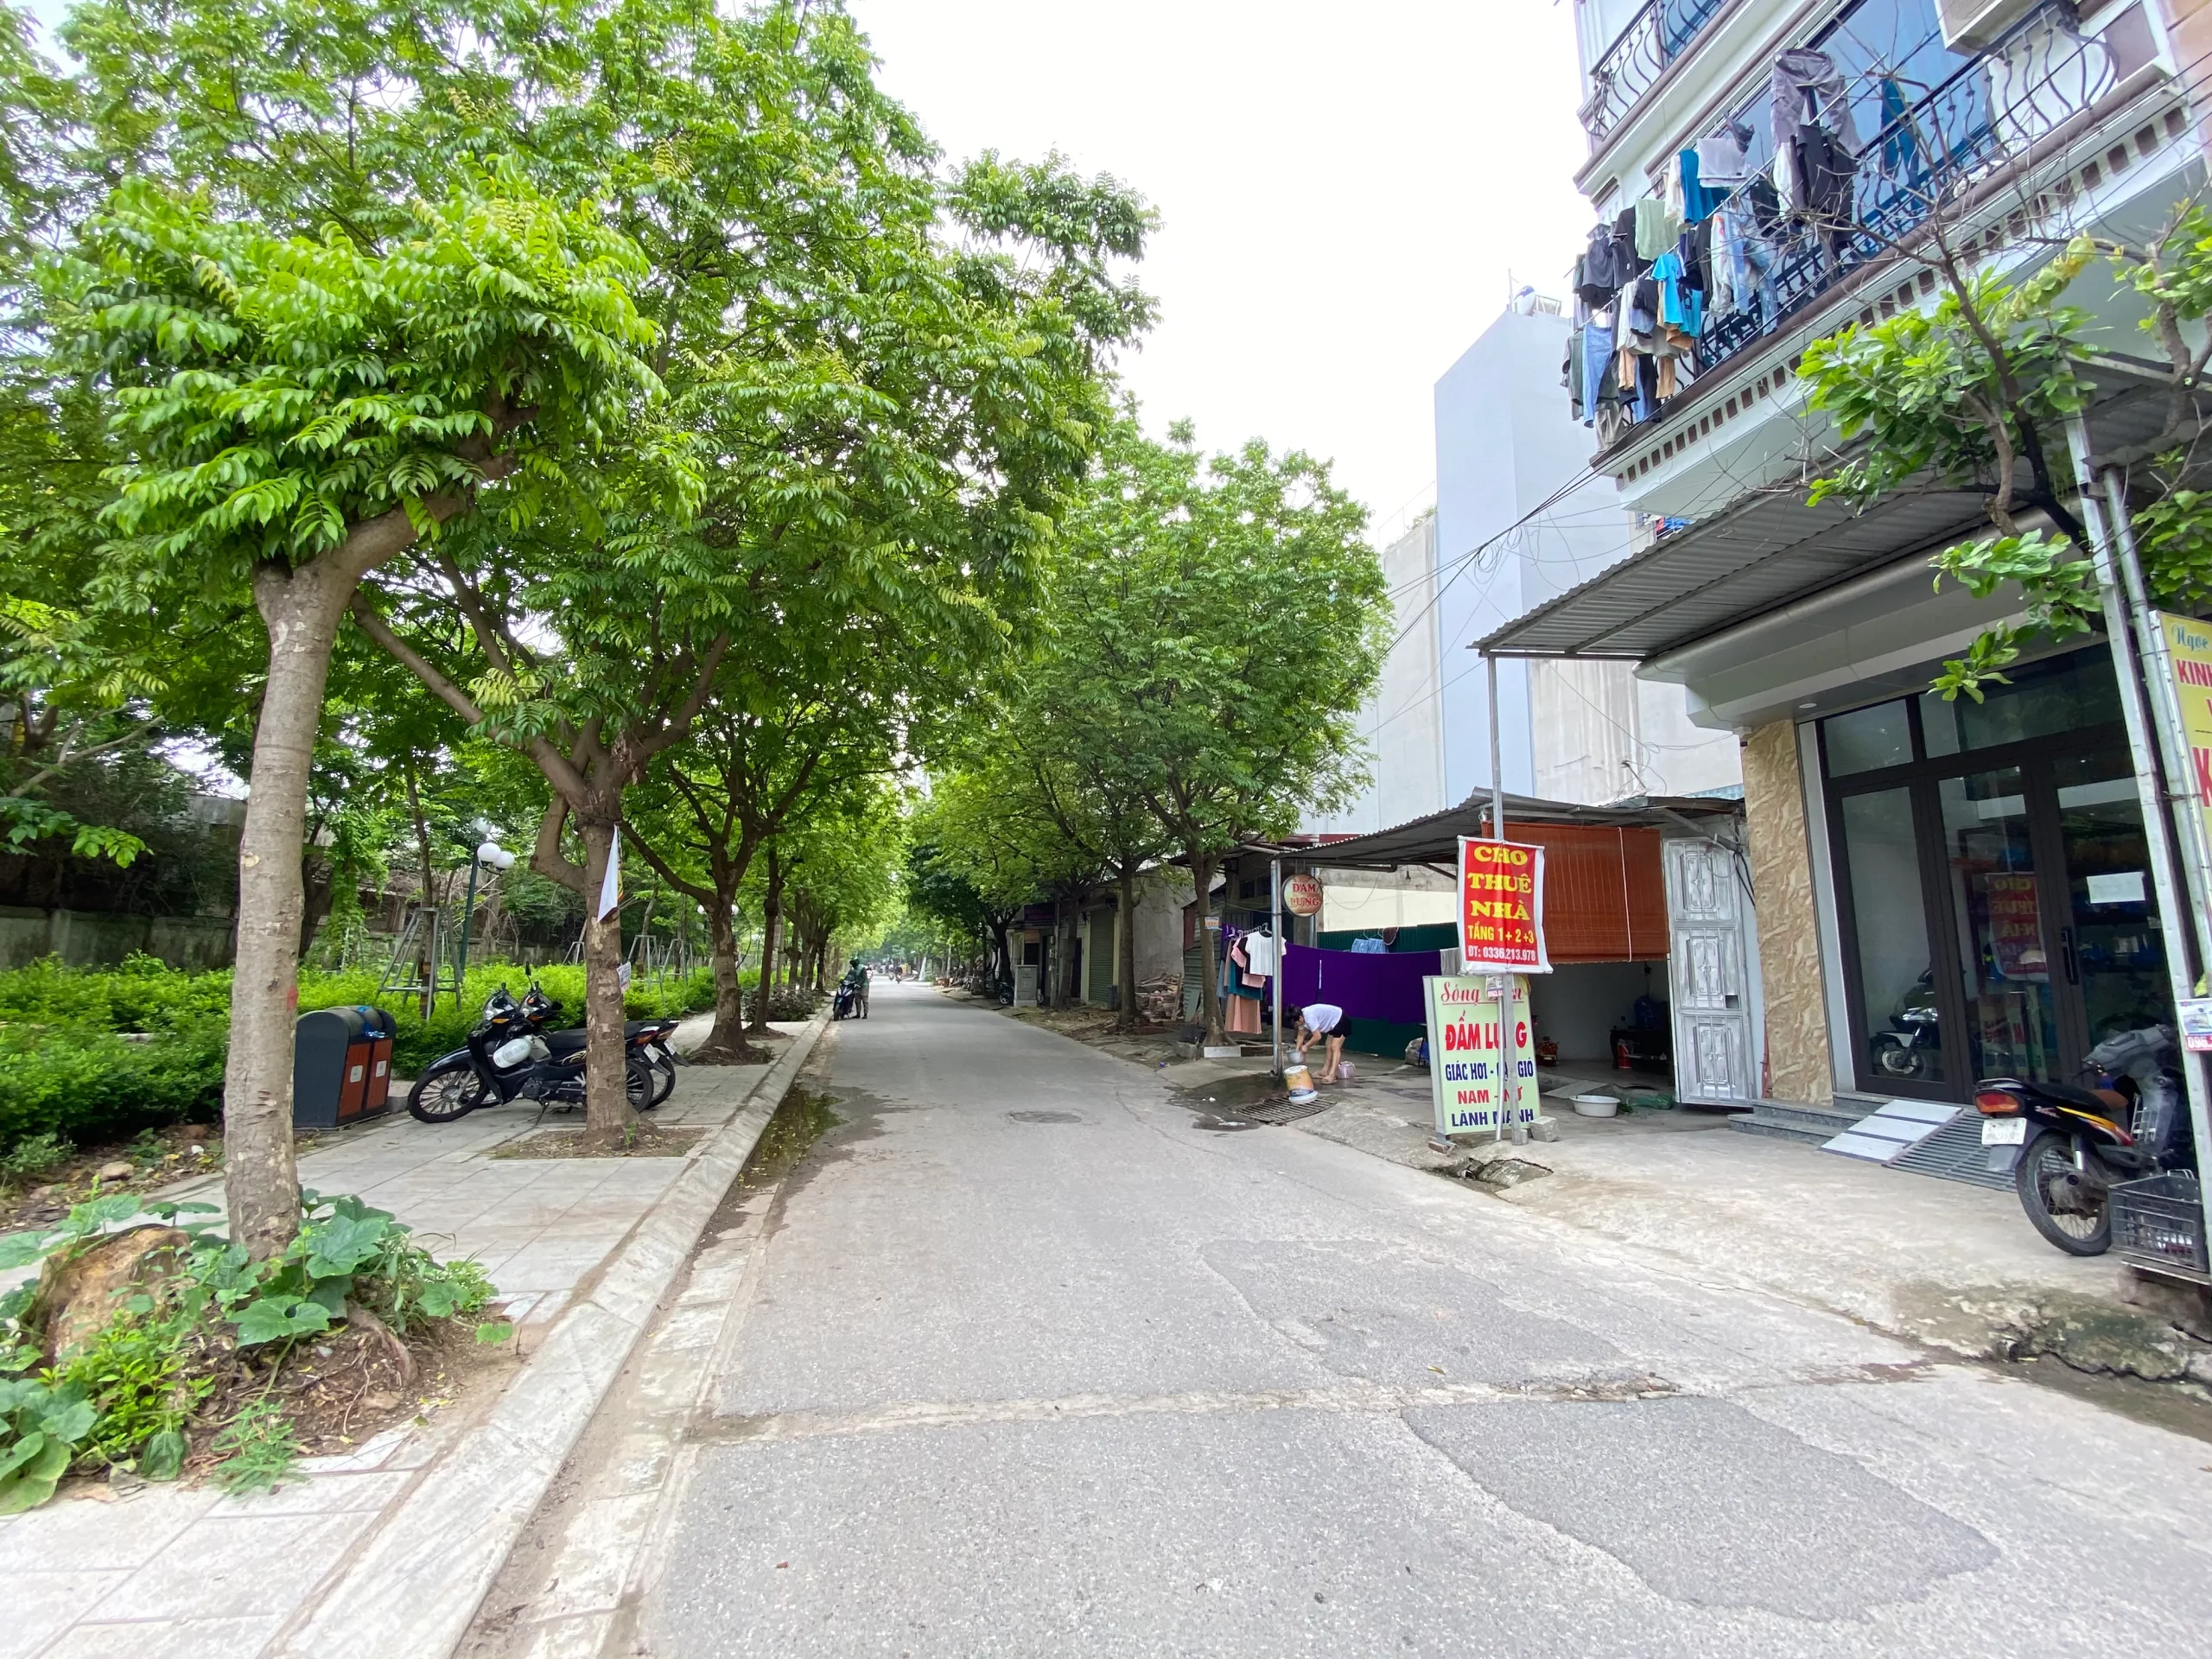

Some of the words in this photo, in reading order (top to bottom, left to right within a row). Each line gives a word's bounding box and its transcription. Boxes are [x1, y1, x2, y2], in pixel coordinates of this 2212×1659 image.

[1474, 846, 1528, 866] CHO
[1467, 873, 1532, 894] THUÊ
[1470, 899, 1530, 921] NHÀ
[1483, 947, 1535, 962] 0336.213.978
[1445, 1009, 1482, 1051] ĐẤM
[1445, 1060, 1468, 1081] GIÁC
[1517, 1056, 1534, 1077] GIÓ
[1457, 1089, 1490, 1104] NAM
[1451, 1109, 1489, 1127] LÀNH
